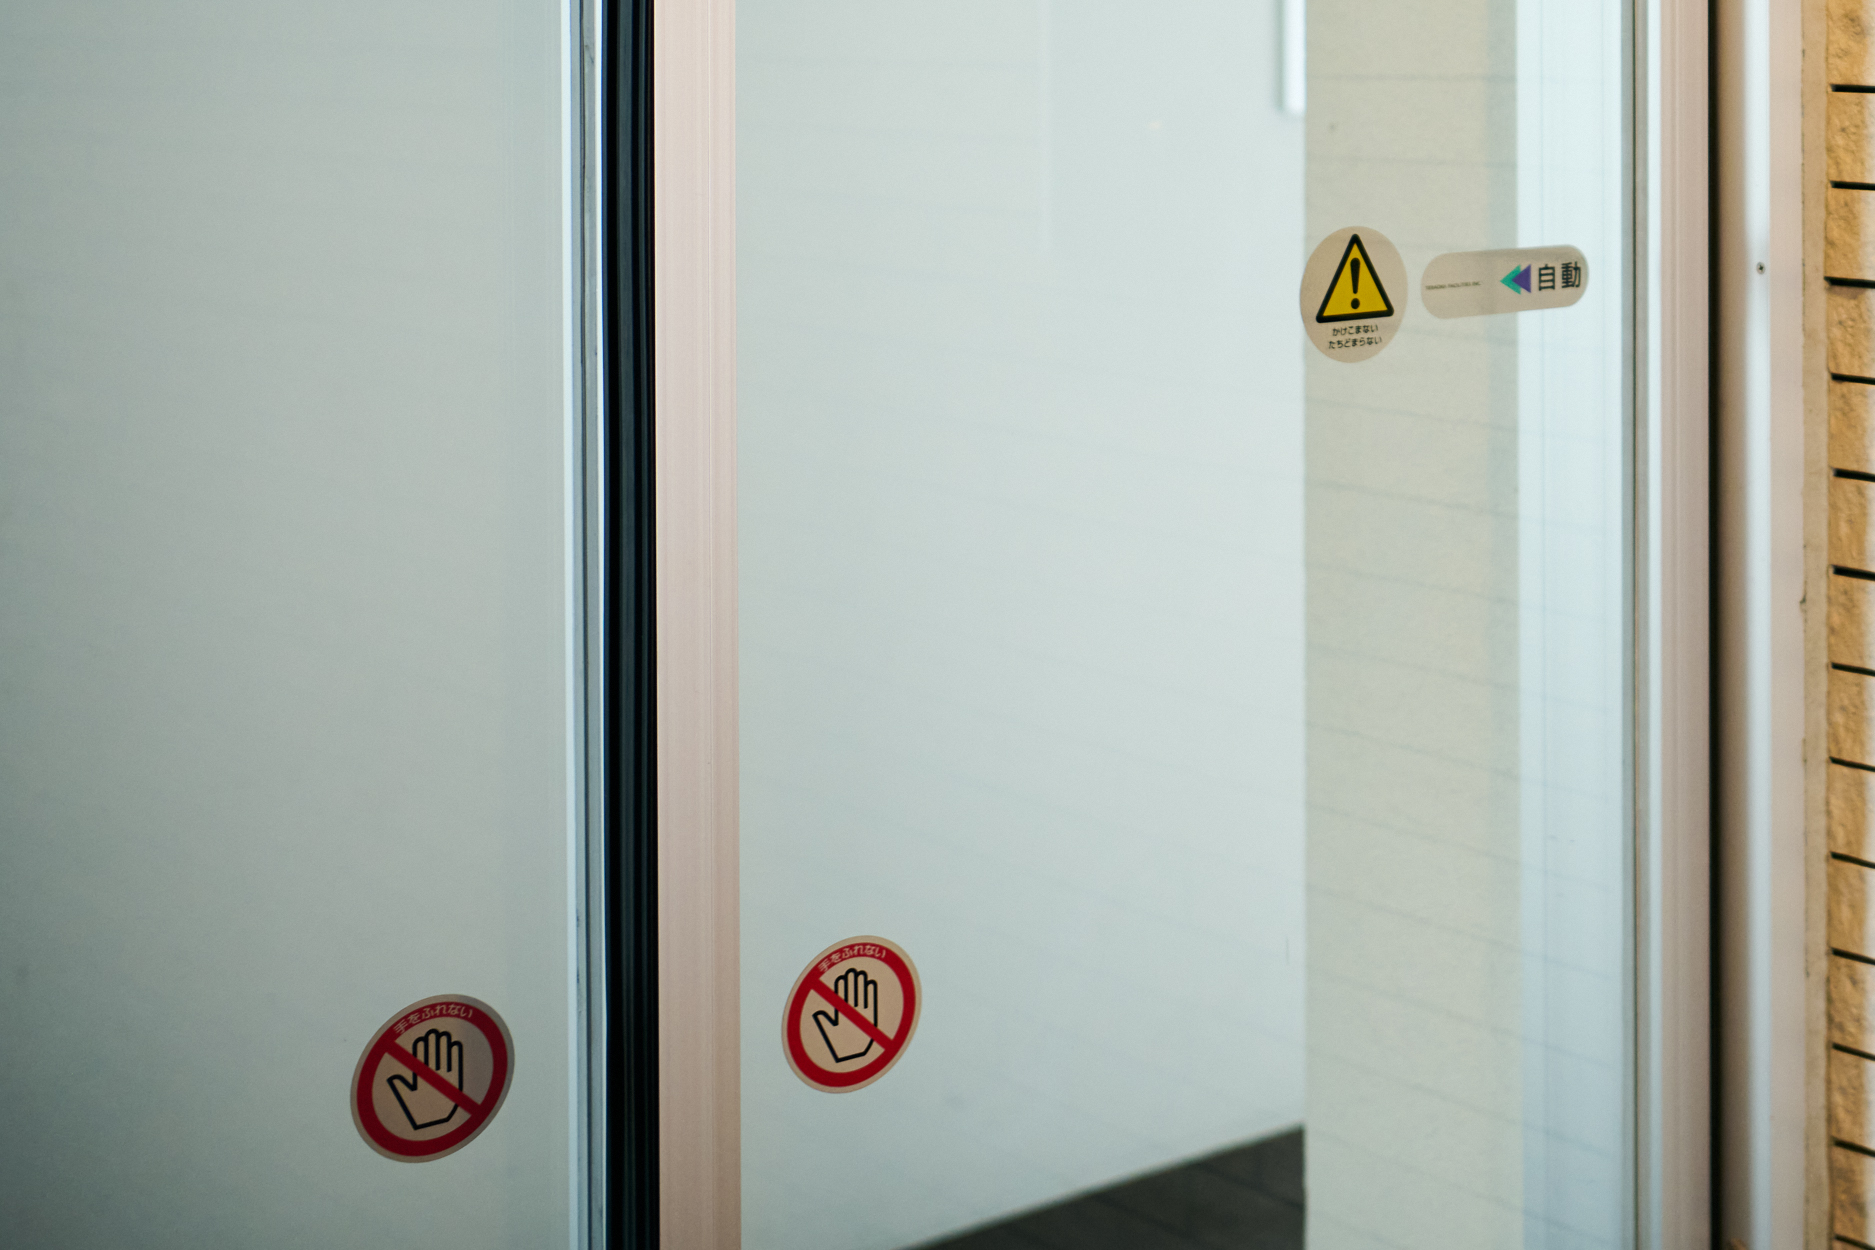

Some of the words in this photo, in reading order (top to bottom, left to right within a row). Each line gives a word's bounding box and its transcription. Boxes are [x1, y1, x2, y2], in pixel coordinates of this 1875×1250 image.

[1538, 261, 1582, 292] 自動
[1328, 336, 1383, 350] たちどまらない
[1332, 324, 1379, 337] かけこまない
[817, 945, 886, 972] 手をふれない
[393, 1003, 473, 1034] 手をふれない
